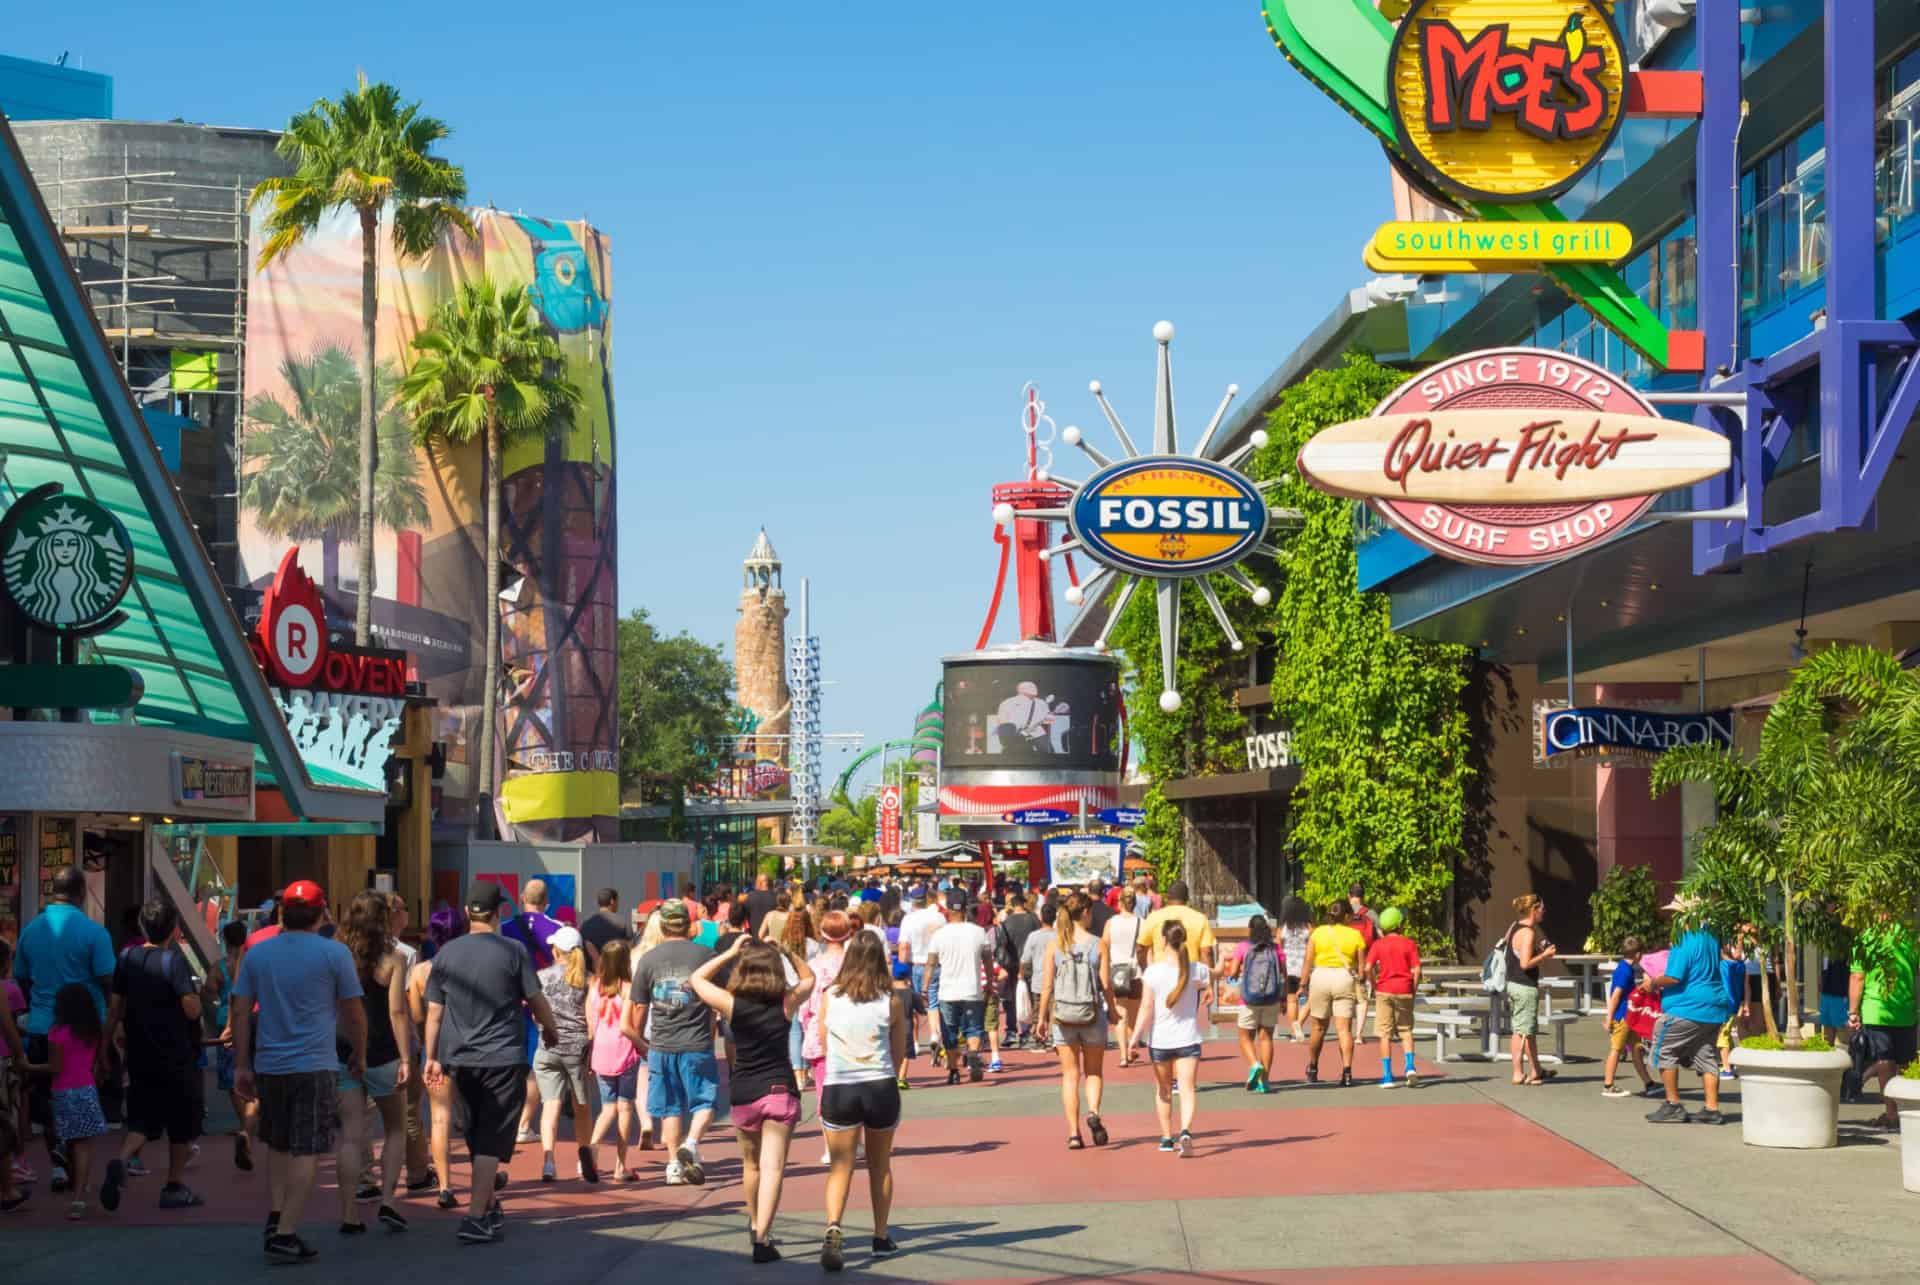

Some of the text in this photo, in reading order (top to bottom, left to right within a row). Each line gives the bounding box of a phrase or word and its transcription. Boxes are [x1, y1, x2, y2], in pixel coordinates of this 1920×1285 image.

[1395, 228, 1612, 255] southwest grill
[1420, 357, 1612, 406] SINCE 1972
[1383, 418, 1658, 494] Quiet Flight
[1101, 499, 1250, 529] FOSSIL
[1420, 503, 1615, 551] SURF SHOP
[287, 621, 307, 660] R
[325, 650, 406, 697] OVEN
[289, 687, 407, 729] BAKERY
[1549, 712, 1735, 750] CINNABON
